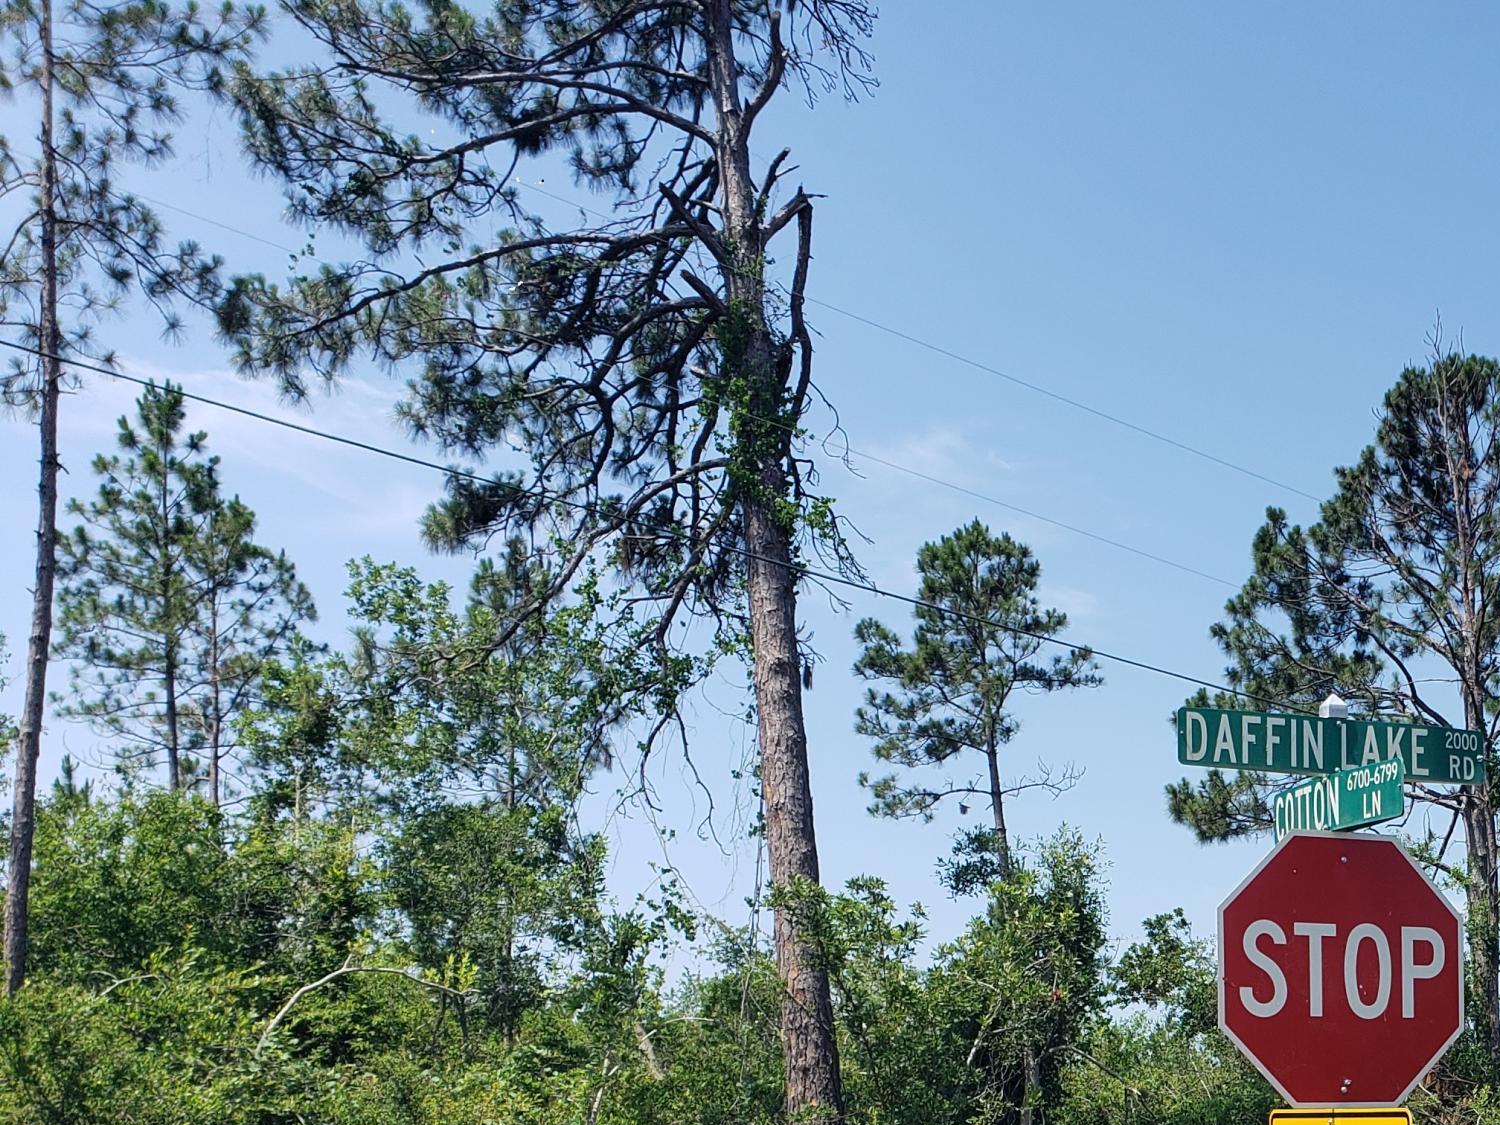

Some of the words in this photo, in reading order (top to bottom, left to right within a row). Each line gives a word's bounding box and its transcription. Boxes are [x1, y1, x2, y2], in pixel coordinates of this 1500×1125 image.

[1186, 711, 1323, 770] DAFFIN
[1341, 723, 1428, 776] LAKE
[1445, 731, 1478, 751] 2000
[1347, 761, 1398, 791] 6700-6799
[1449, 755, 1475, 780] RD
[1276, 776, 1339, 842] COTTON
[1363, 790, 1381, 818] LN
[1239, 919, 1445, 1019] STOP
